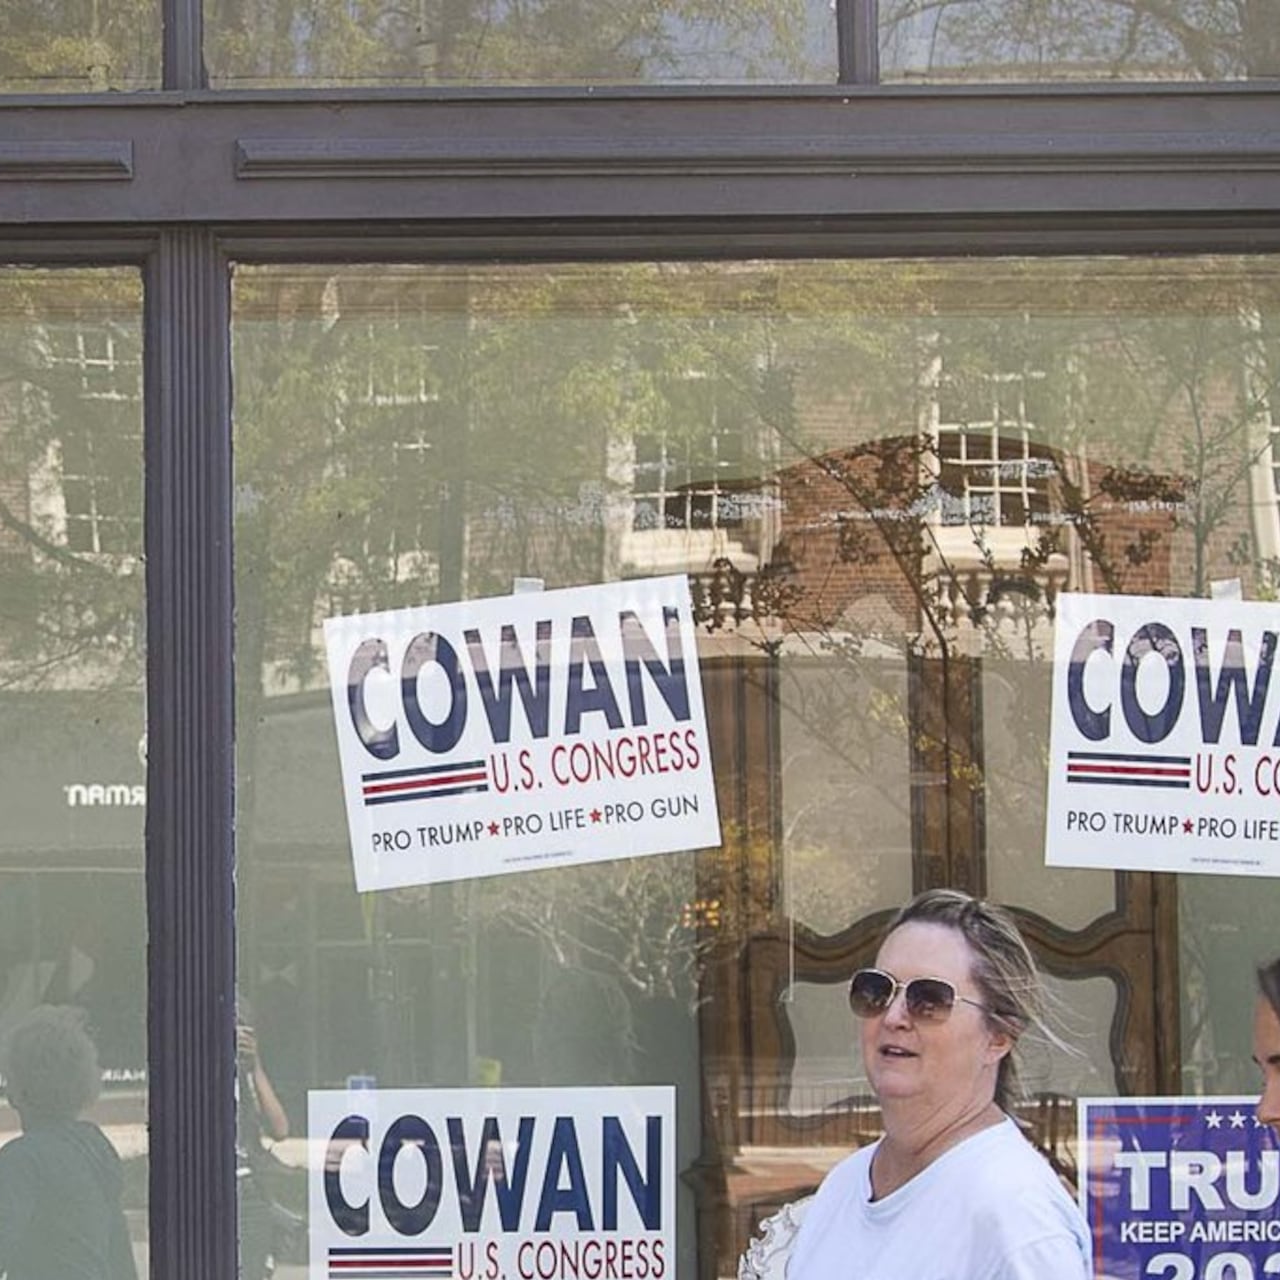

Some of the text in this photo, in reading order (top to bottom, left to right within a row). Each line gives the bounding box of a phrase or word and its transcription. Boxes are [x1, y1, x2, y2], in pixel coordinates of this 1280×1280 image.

[347, 605, 691, 761] COWAN
[491, 729, 701, 793] U.S. CONGRESS
[1195, 753, 1243, 796] U.S.
[372, 794, 700, 852] PRO TRUMP PRO LIFE PRO GUN
[1067, 811, 1106, 832] PRO
[1113, 813, 1179, 836] TRUMP
[1198, 818, 1237, 839] PRO
[1244, 819, 1279, 841] LIFE
[323, 1114, 662, 1236] COWAN
[1120, 1221, 1185, 1243] KEEP
[459, 1239, 665, 1280] U.S. CONGRESS
